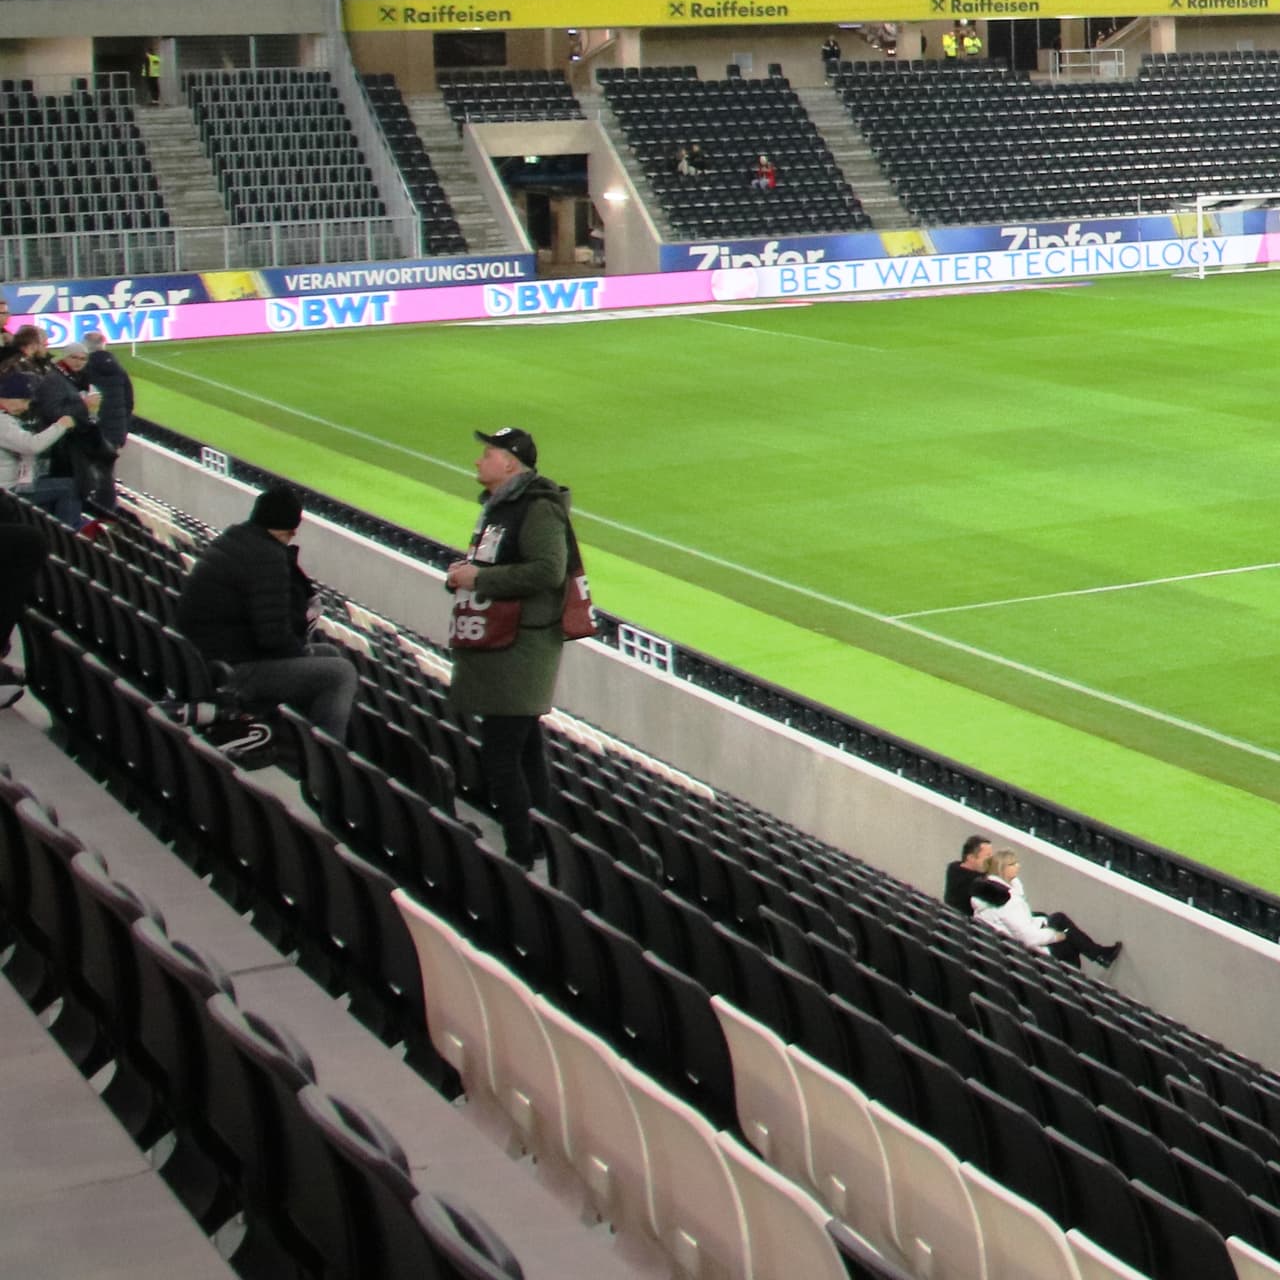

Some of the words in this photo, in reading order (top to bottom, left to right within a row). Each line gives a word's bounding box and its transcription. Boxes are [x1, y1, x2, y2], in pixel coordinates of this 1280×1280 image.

[403, 6, 512, 24] Raiffeisen
[691, 1, 789, 19] Raiffeisen
[285, 260, 525, 292] VERANTWORTUNGSVOLL
[780, 263, 865, 293] BEST
[874, 255, 993, 286] WATER
[1004, 239, 1229, 278] TECHNOLOGY
[302, 295, 391, 327] BWT
[517, 281, 599, 313] BWT
[74, 309, 170, 349] BWT
